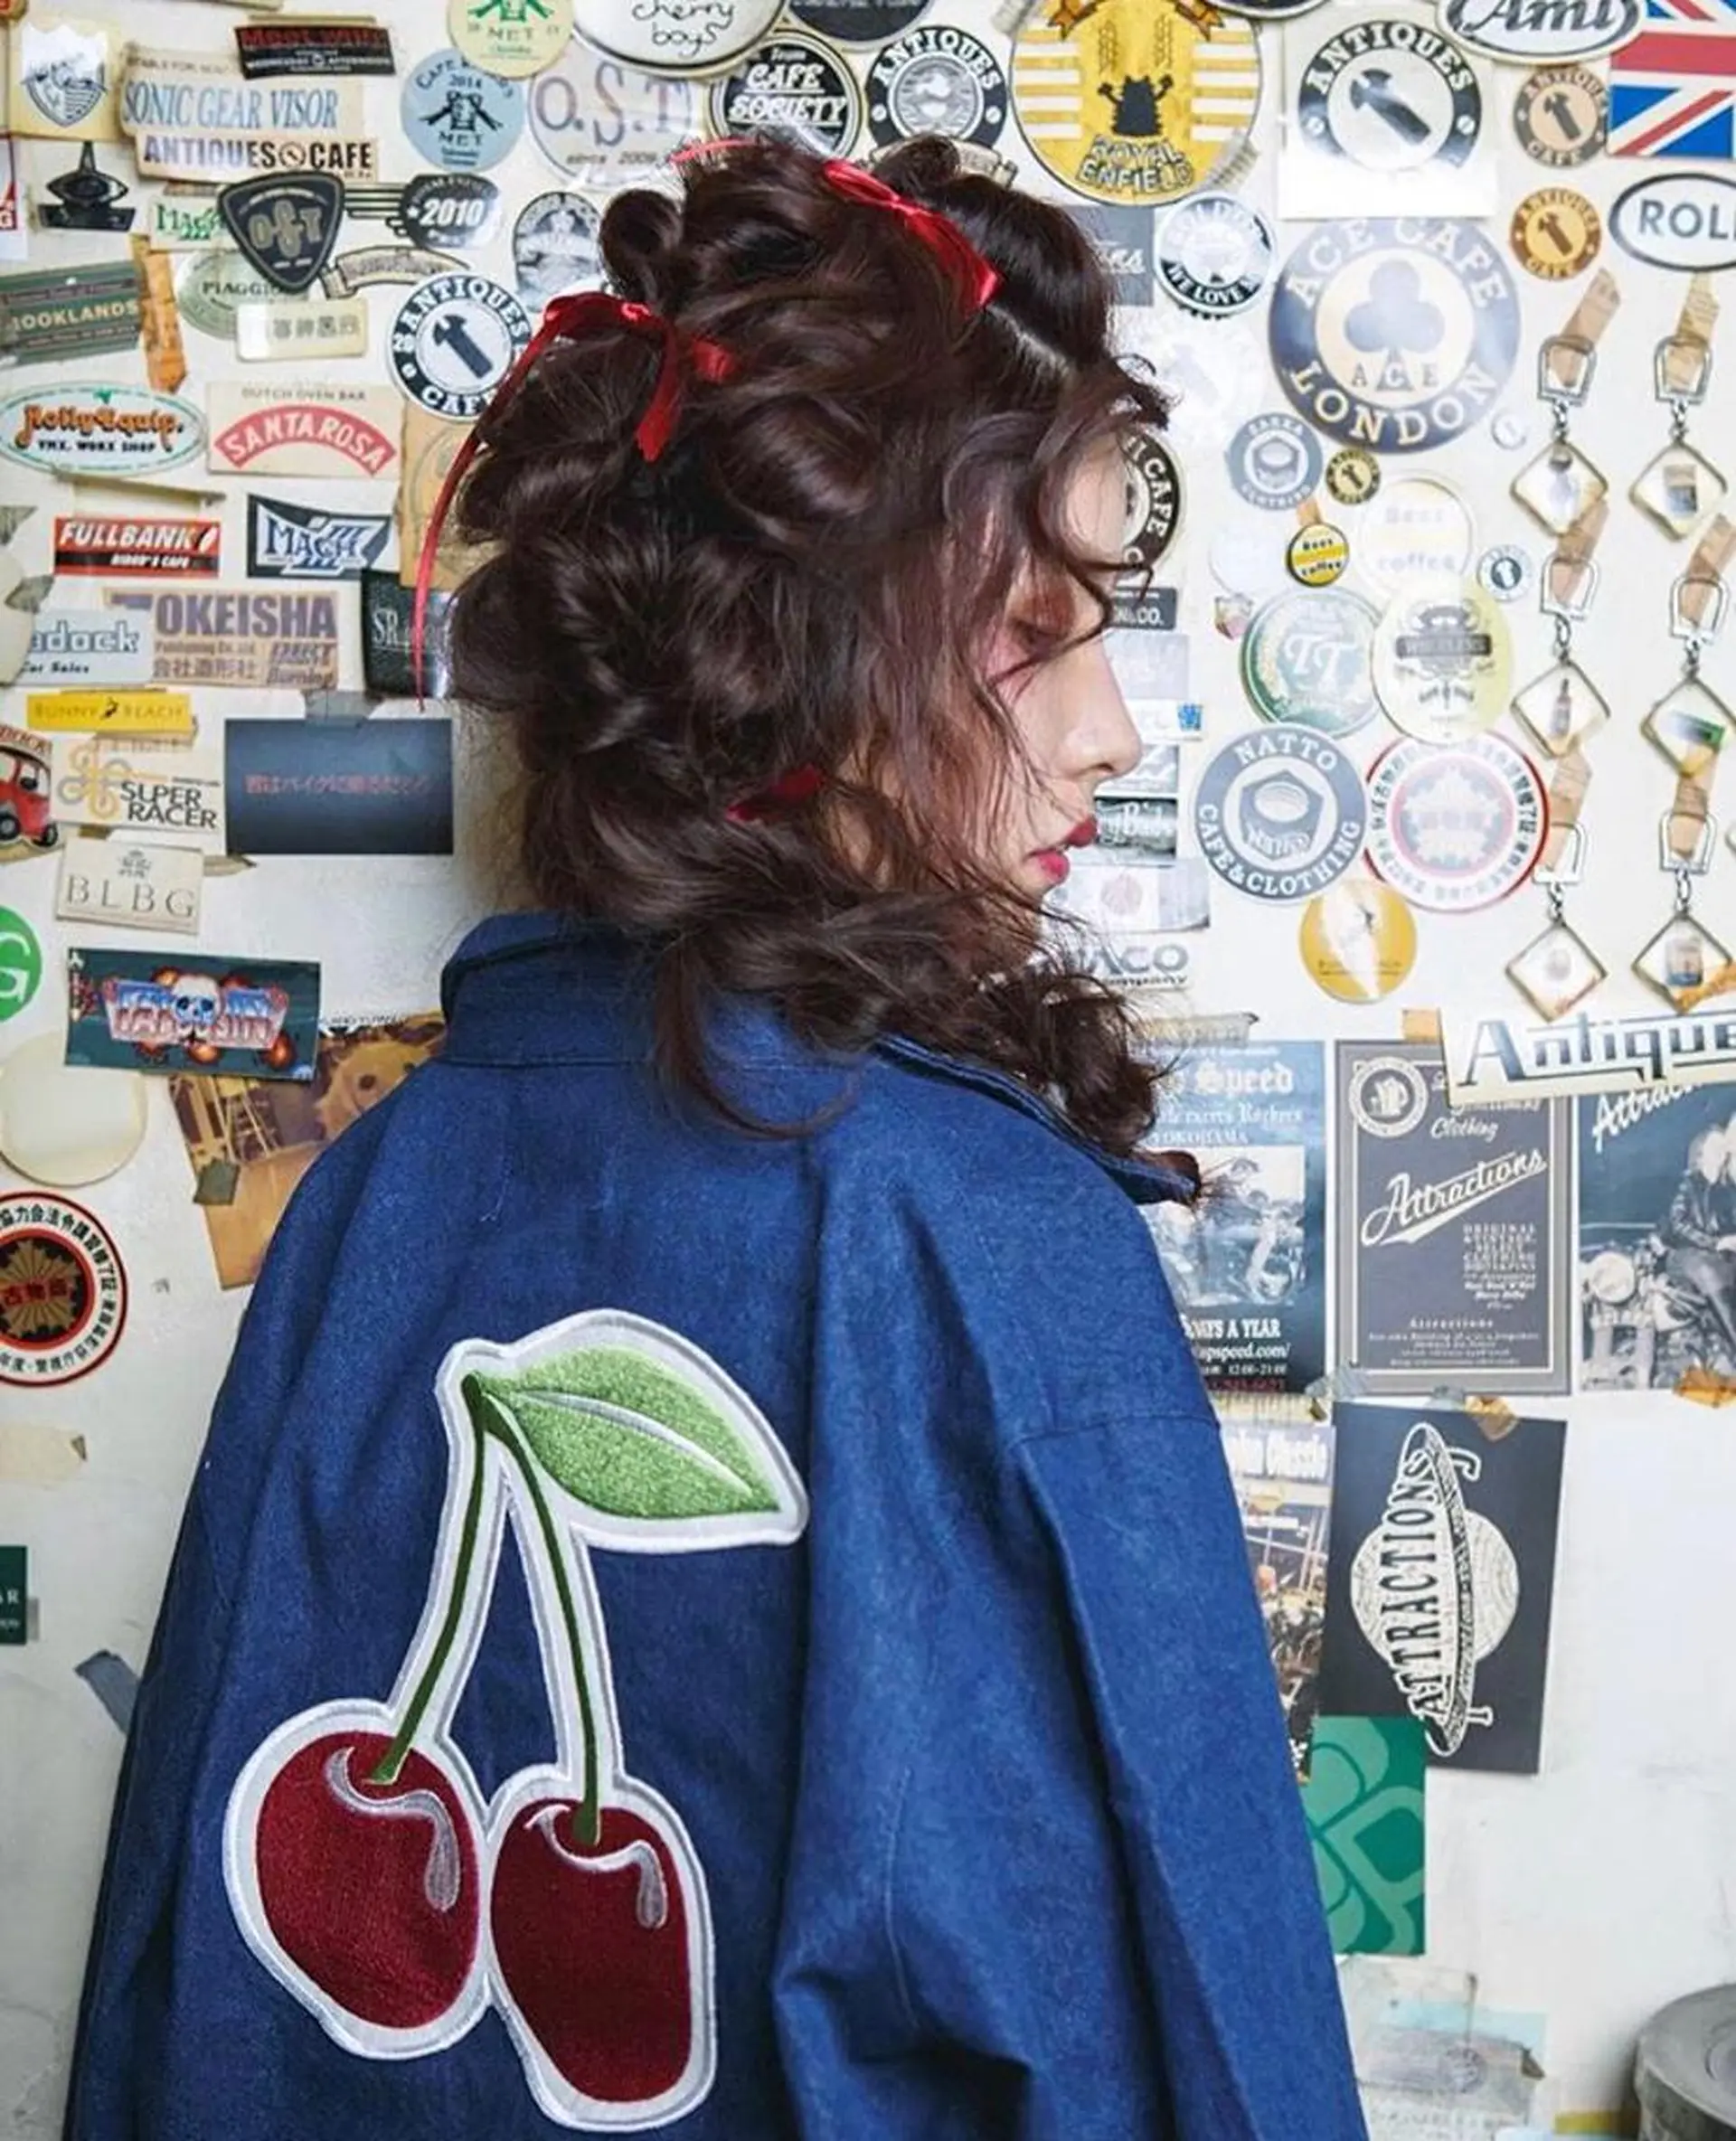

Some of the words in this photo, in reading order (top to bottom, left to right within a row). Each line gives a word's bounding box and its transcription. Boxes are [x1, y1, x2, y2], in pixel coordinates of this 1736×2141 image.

[873, 28, 1002, 90] ANTIQUES
[1305, 22, 1476, 94] ANTIQUES
[746, 62, 825, 90] CAFE
[123, 80, 193, 127] SONIC
[197, 87, 262, 129] GEAR
[270, 90, 339, 129] VISOR
[729, 95, 847, 122] SOCIETY
[144, 137, 276, 168] ANTIQUES
[309, 143, 372, 169] CAFE
[1091, 136, 1184, 168] ROYAL
[1080, 156, 1194, 193] ENFIELD
[419, 198, 484, 227] 2010
[1287, 221, 1375, 309] ACE
[410, 278, 529, 340] ANTIQUES
[1194, 288, 1244, 307] LOVE
[1352, 362, 1439, 389] ACE
[241, 388, 292, 400] DUTCH
[338, 389, 366, 401] BAR
[1284, 360, 1498, 446] LONDON
[1144, 458, 1175, 539] CAFE
[61, 520, 193, 550] FULLBANK
[1234, 733, 1338, 770] NATTO
[121, 780, 203, 809] SUPER
[127, 801, 218, 829] RACER
[67, 874, 196, 920] BLBG
[1361, 1145, 1549, 1247] Attractions
[1241, 1317, 1281, 1339] YEAR
[1380, 1449, 1449, 1715] ATTRACTIONS
